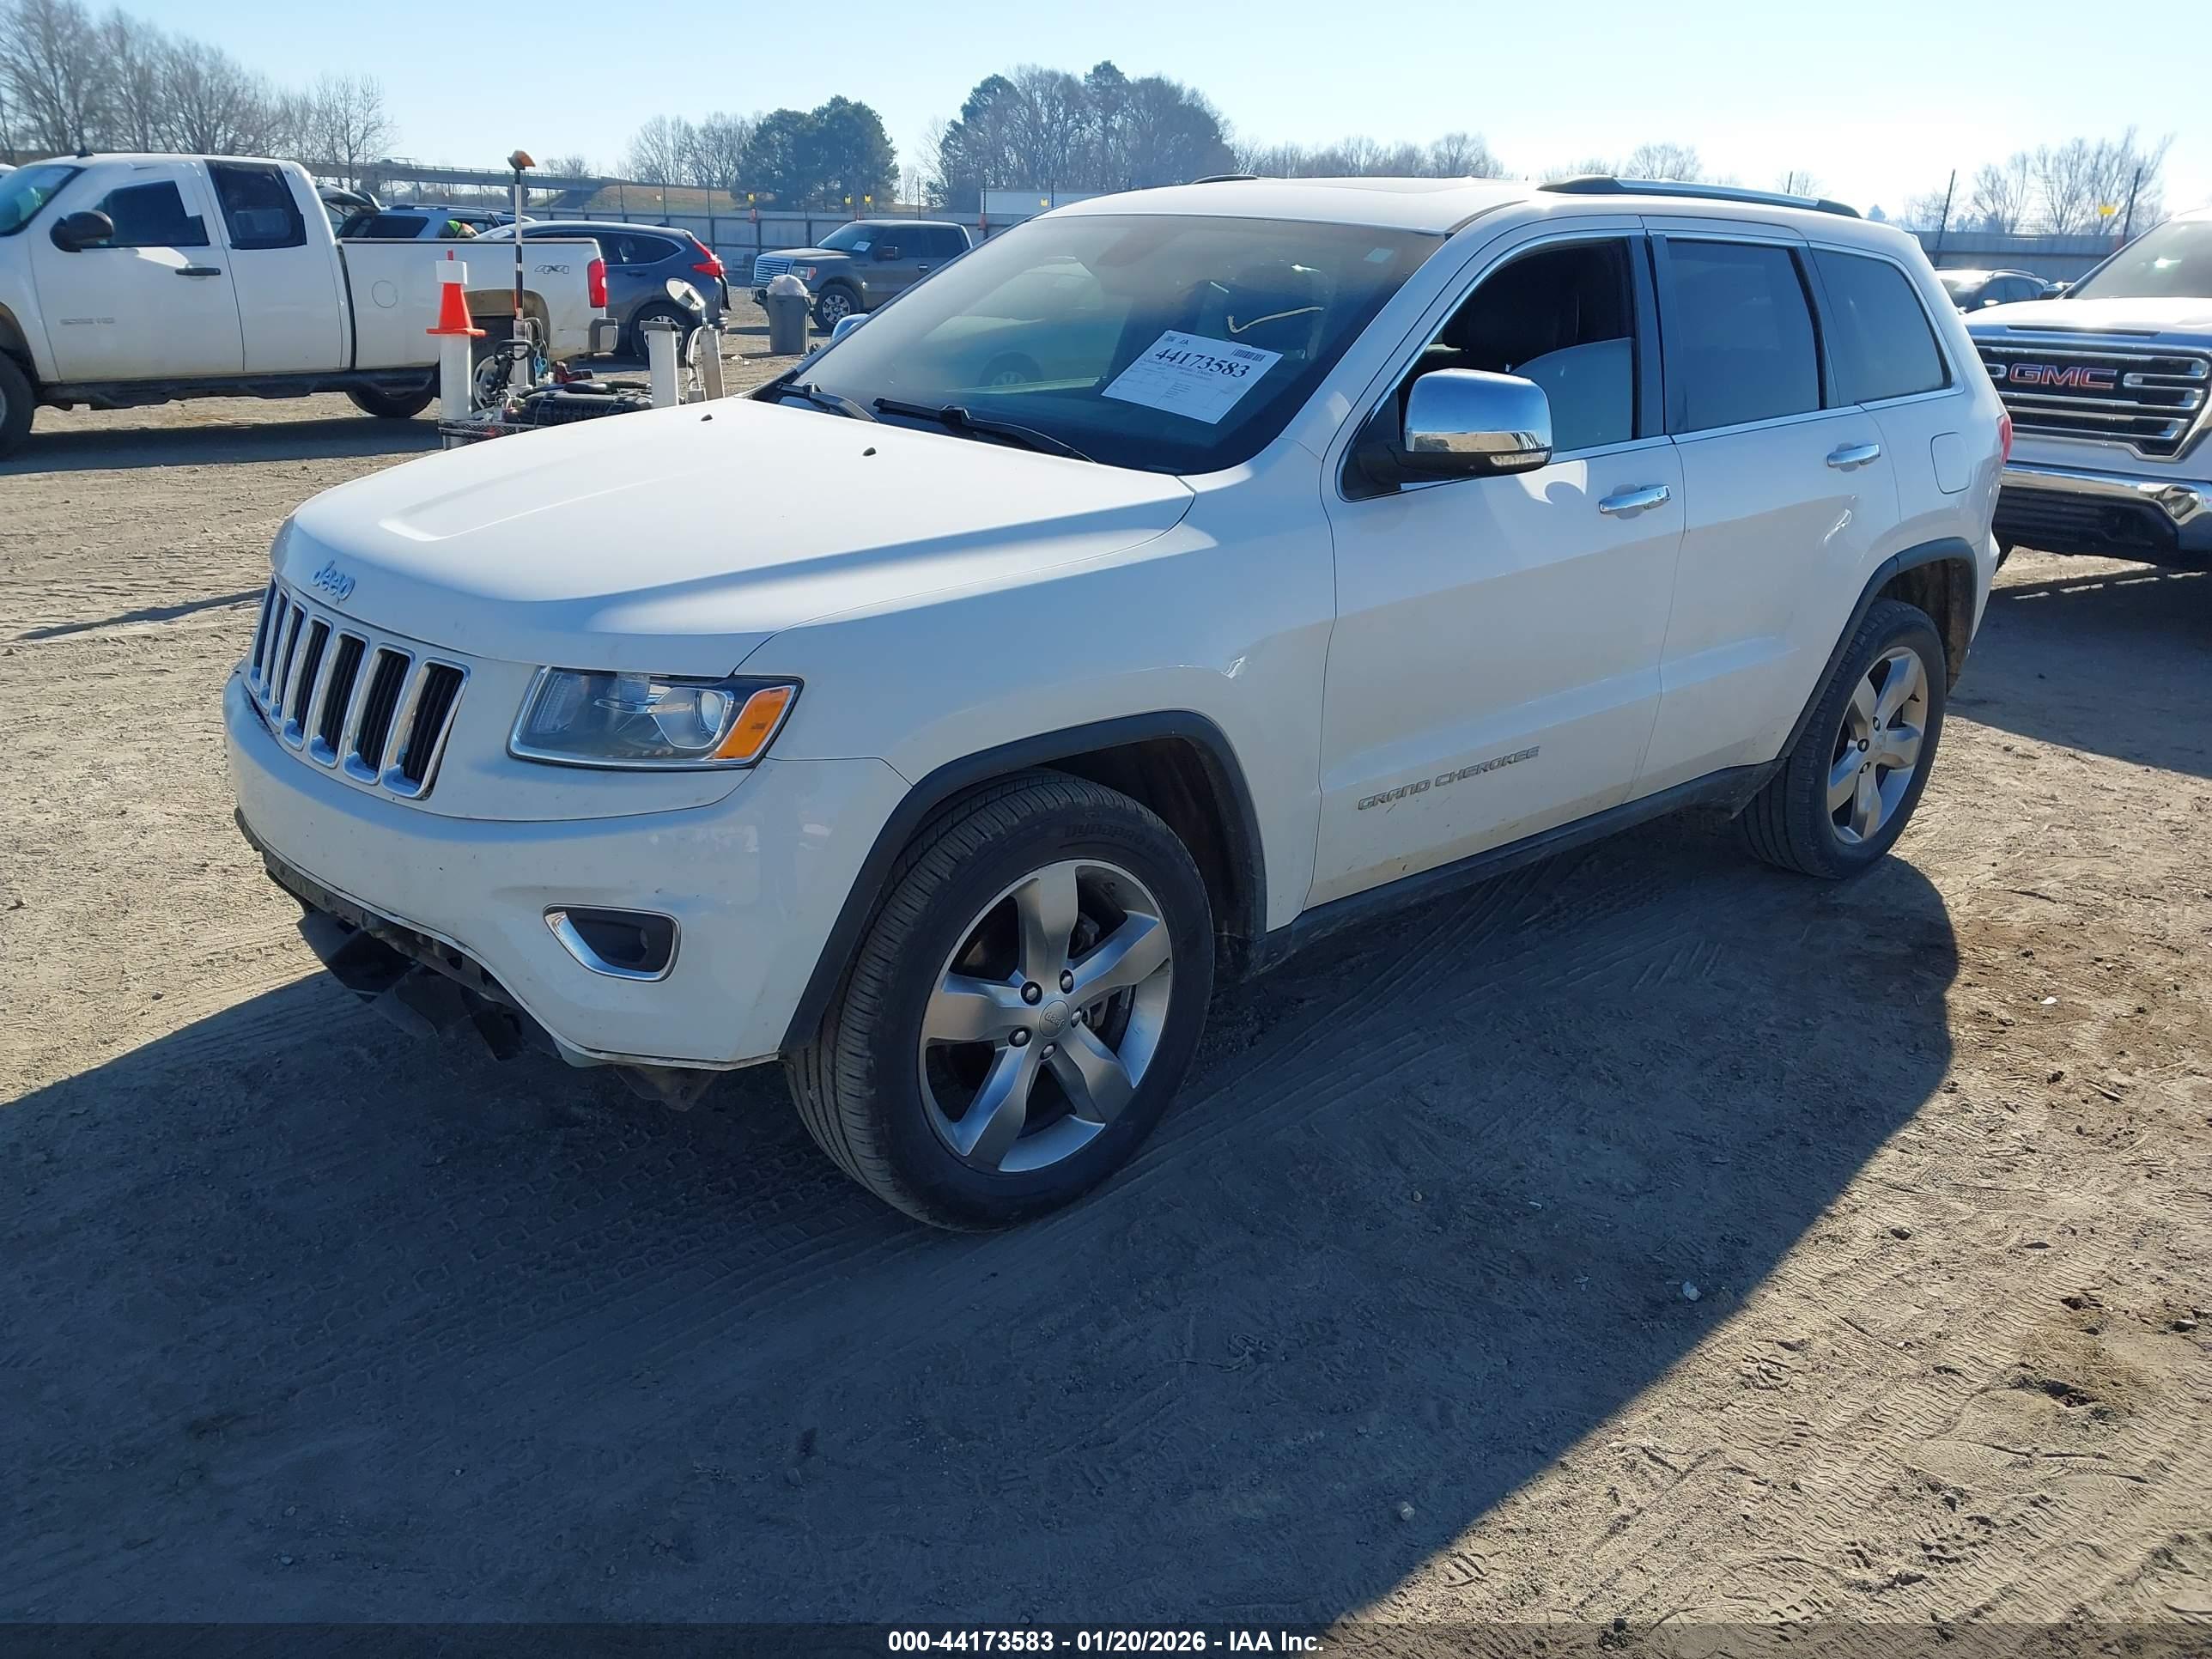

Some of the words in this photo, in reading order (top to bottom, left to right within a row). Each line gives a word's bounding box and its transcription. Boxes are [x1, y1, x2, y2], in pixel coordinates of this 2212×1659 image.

[1154, 348, 1250, 378] 44173583
[2009, 362, 2118, 389] GMC
[310, 560, 356, 605] Jeep
[1358, 779, 1431, 811] GRAND
[1435, 745, 1541, 787] CHEROKEE
